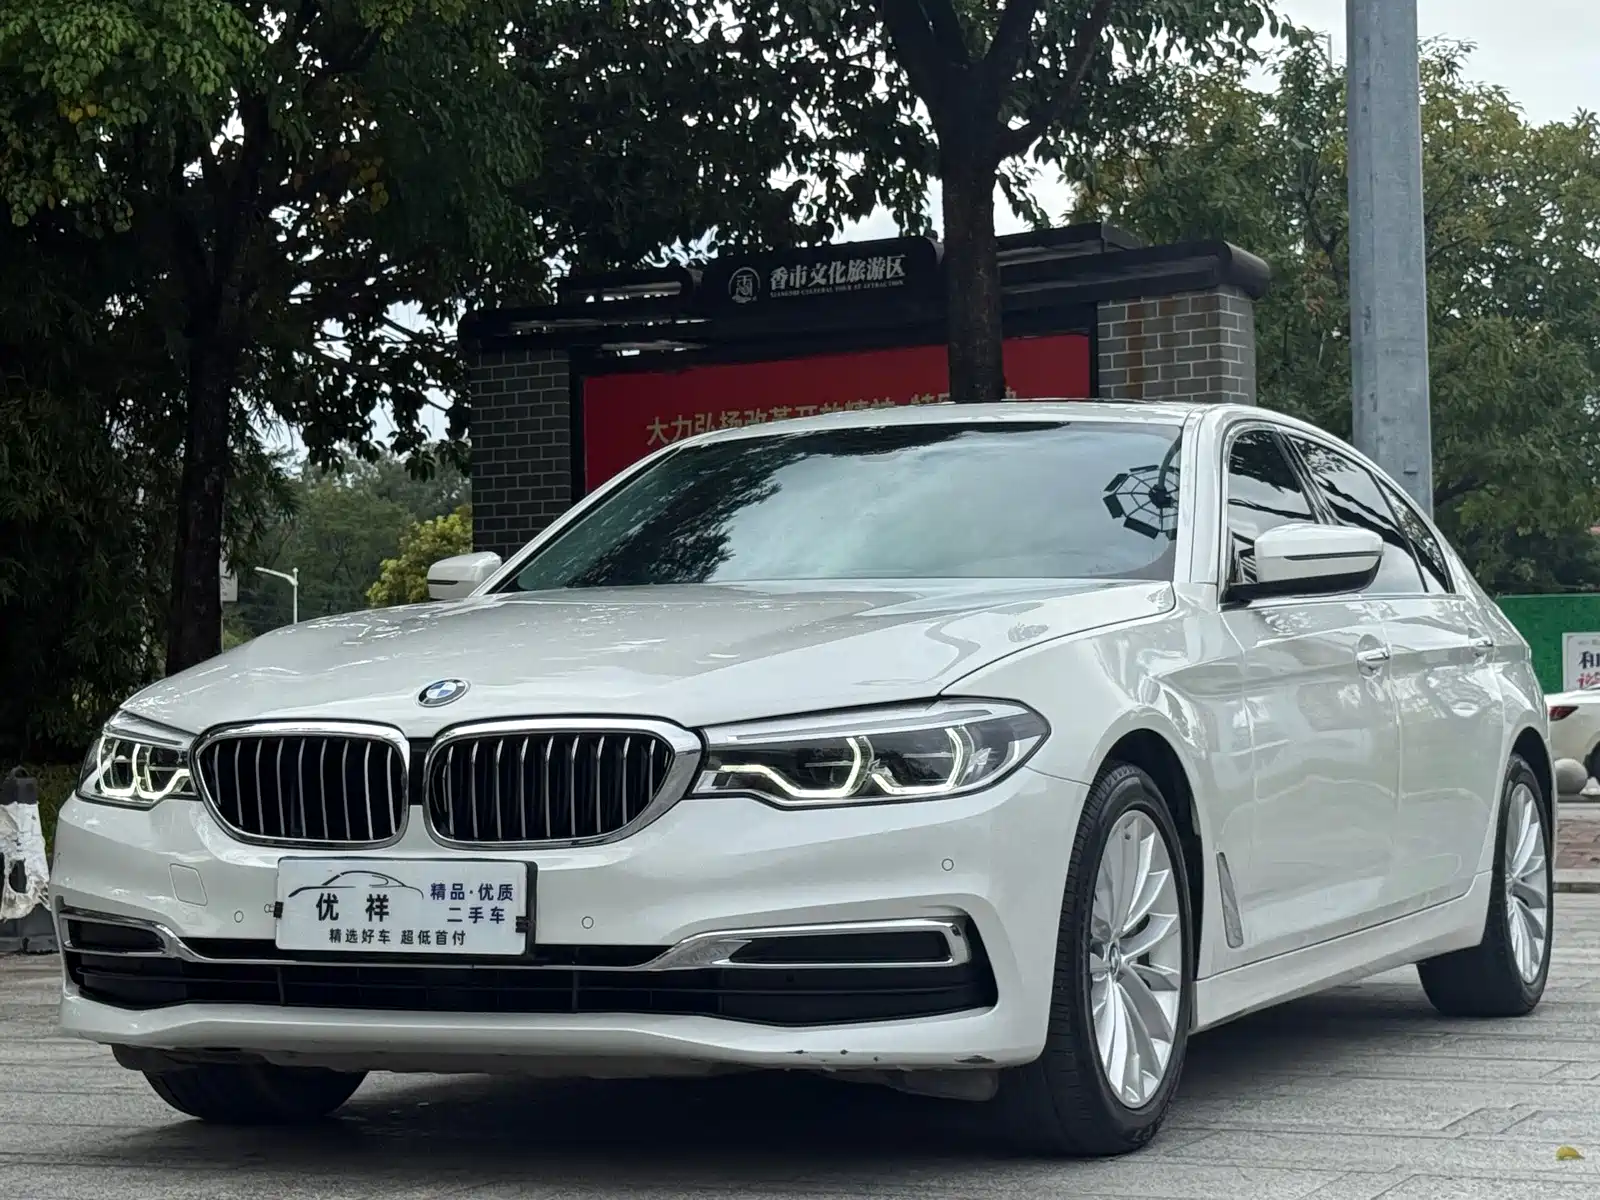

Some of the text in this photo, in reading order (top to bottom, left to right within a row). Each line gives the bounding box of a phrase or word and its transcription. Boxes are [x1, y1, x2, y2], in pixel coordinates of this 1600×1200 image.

[770, 254, 906, 290] 香市文化旅游区
[430, 882, 514, 901] 精品·优质
[447, 906, 506, 924] 二手车
[328, 928, 467, 946] 精选好车 超低首付
